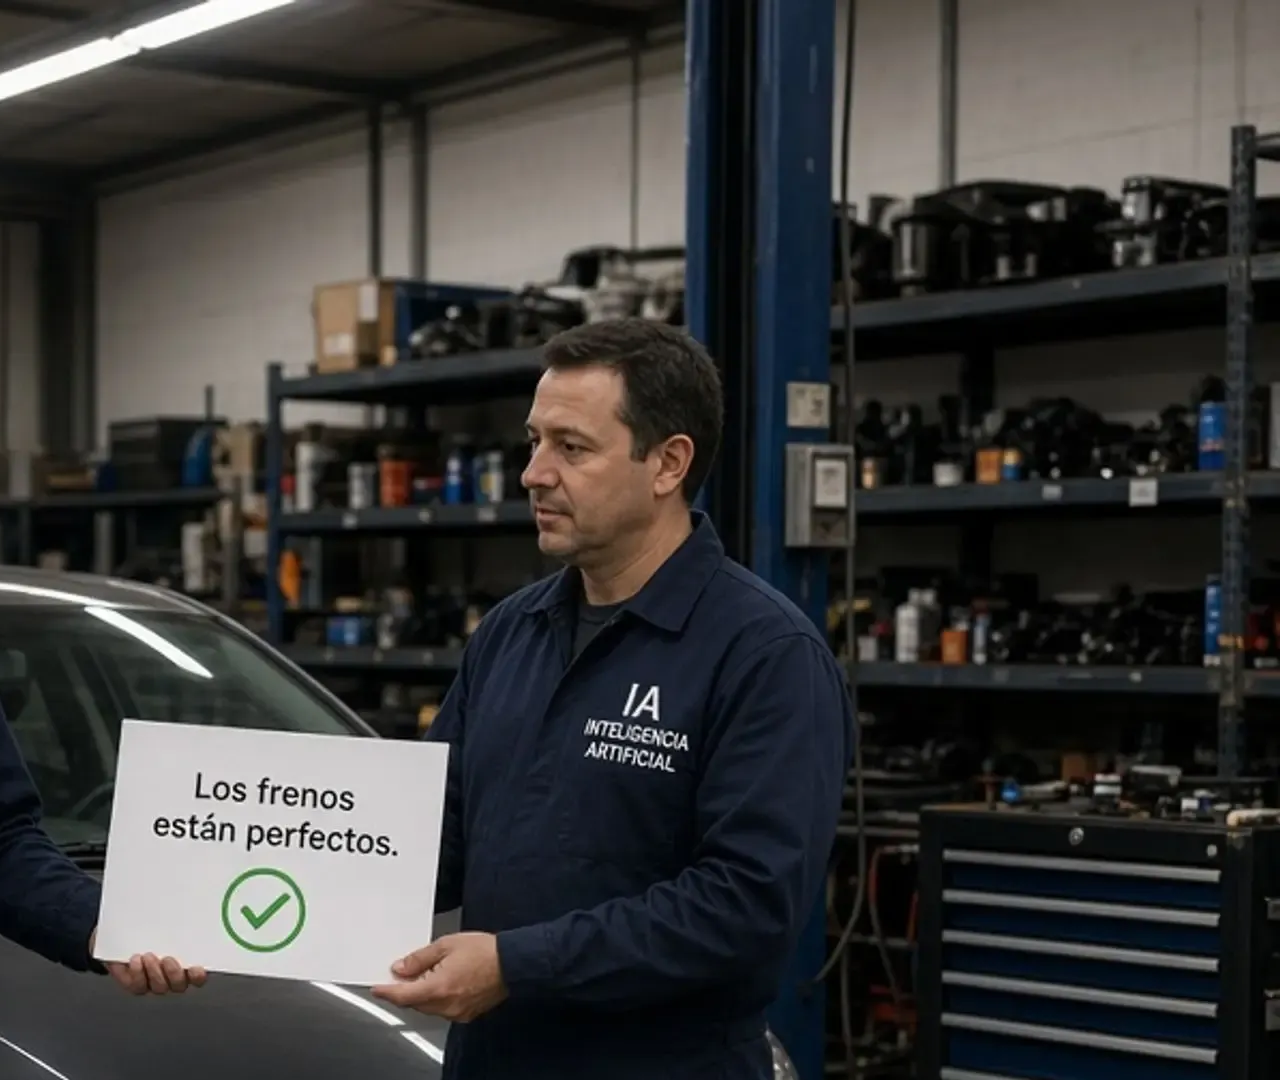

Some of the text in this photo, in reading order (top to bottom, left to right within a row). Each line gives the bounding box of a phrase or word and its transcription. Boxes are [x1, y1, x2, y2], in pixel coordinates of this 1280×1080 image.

[622, 682, 660, 722] IA
[583, 741, 676, 773] ARTIFICIAL
[194, 771, 356, 812] Los frenos
[152, 812, 399, 857] están perfectos.
